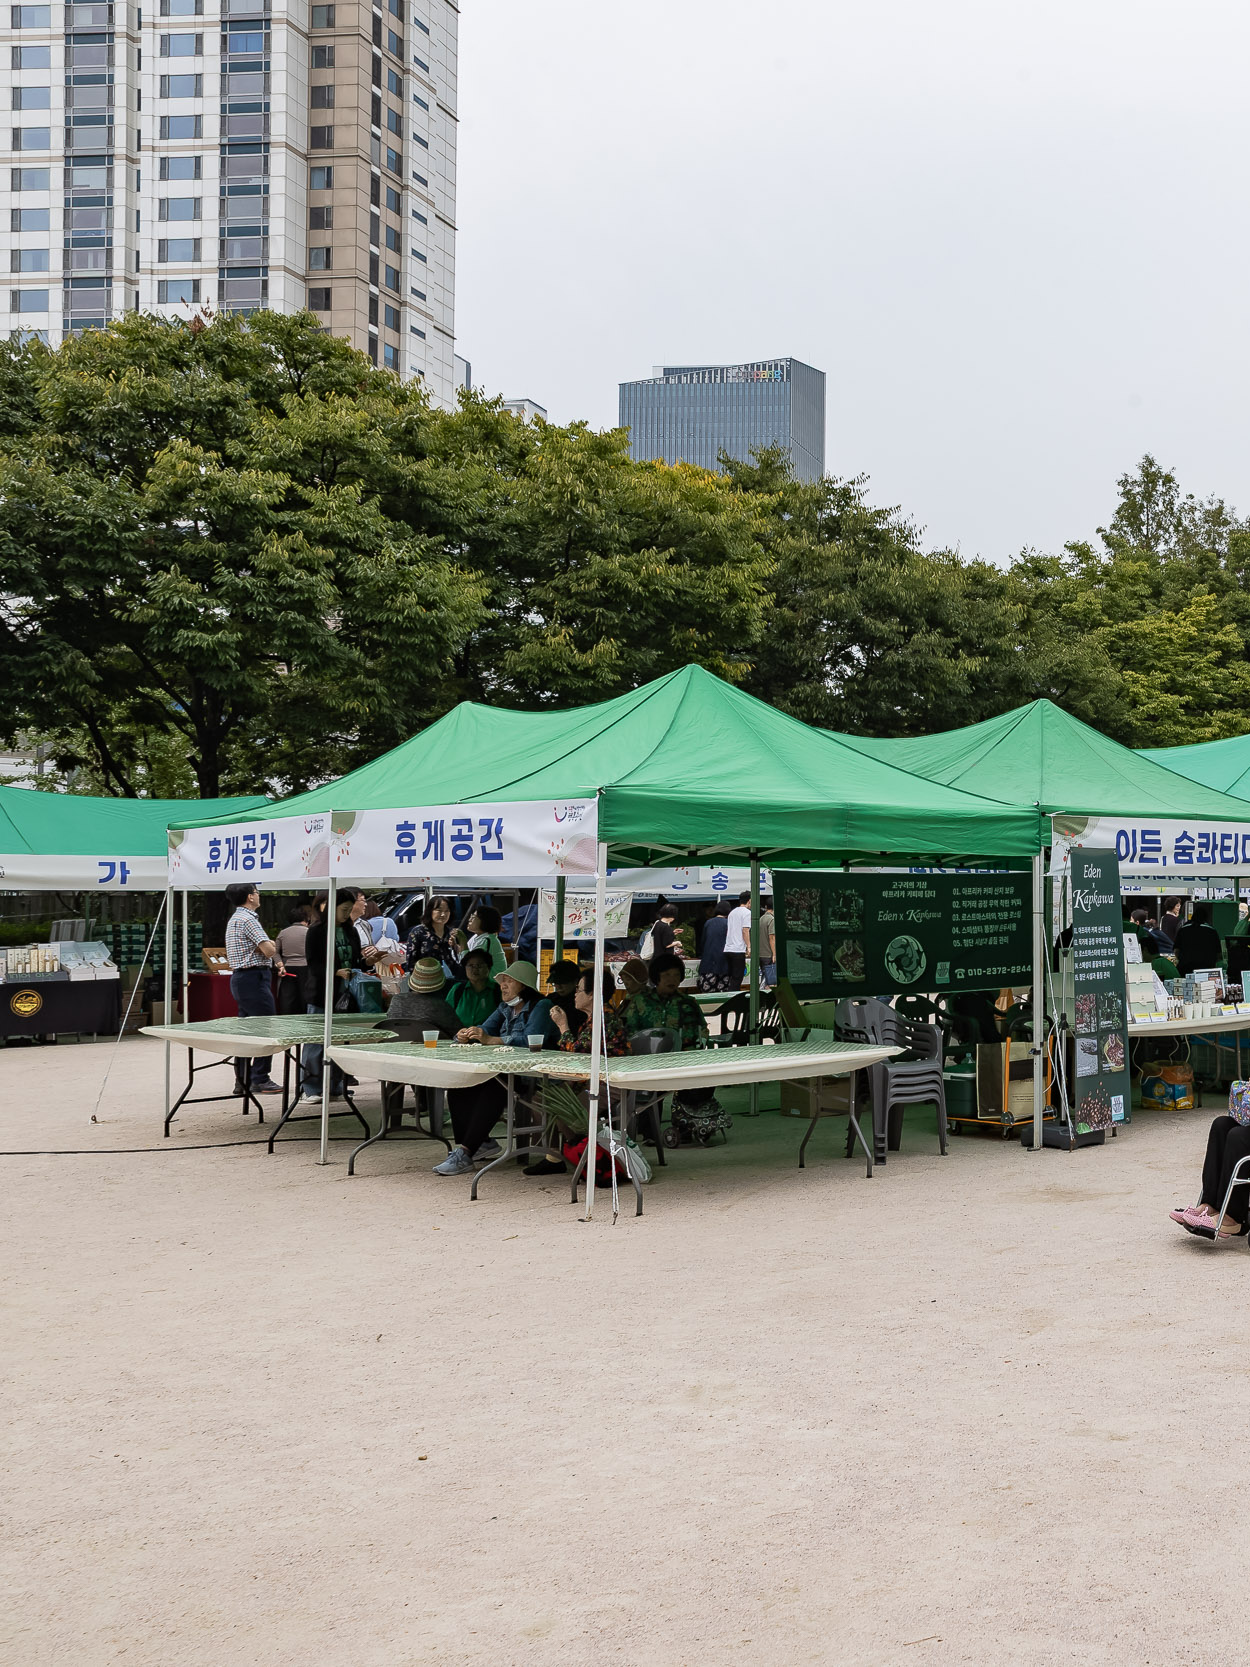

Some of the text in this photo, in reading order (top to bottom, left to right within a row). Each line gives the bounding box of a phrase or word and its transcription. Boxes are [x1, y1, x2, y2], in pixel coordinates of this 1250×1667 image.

[395, 817, 504, 864] 휴게공간
[1116, 829, 1167, 866] 이든,
[206, 832, 276, 873] 휴게공간
[1083, 863, 1102, 878] Eden
[961, 887, 982, 895] 아프리카
[1072, 889, 1114, 912] Kapkawa
[877, 910, 898, 921] Eden
[967, 964, 1032, 976] 010-2372-2244
